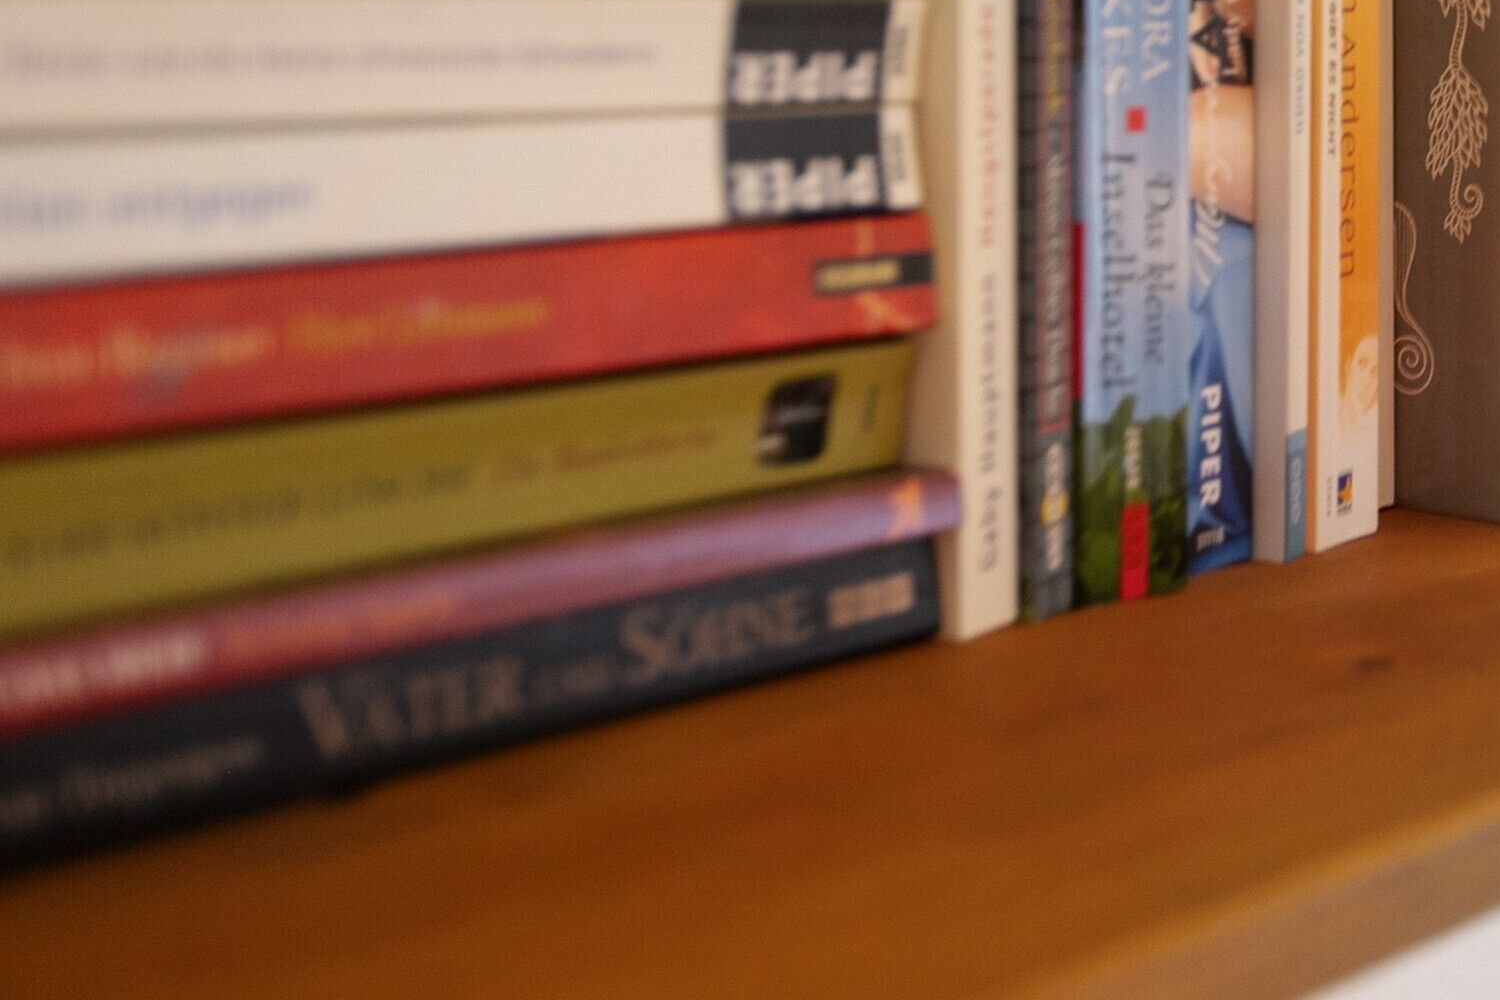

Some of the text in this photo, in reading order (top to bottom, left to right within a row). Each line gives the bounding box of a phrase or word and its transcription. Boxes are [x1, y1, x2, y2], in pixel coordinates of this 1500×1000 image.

[731, 50, 878, 105] PIPER
[729, 156, 877, 218] PIPER
[1143, 174, 1174, 250] Das
[1100, 152, 1139, 390] Inselhotel
[1199, 383, 1222, 509] PIPER
